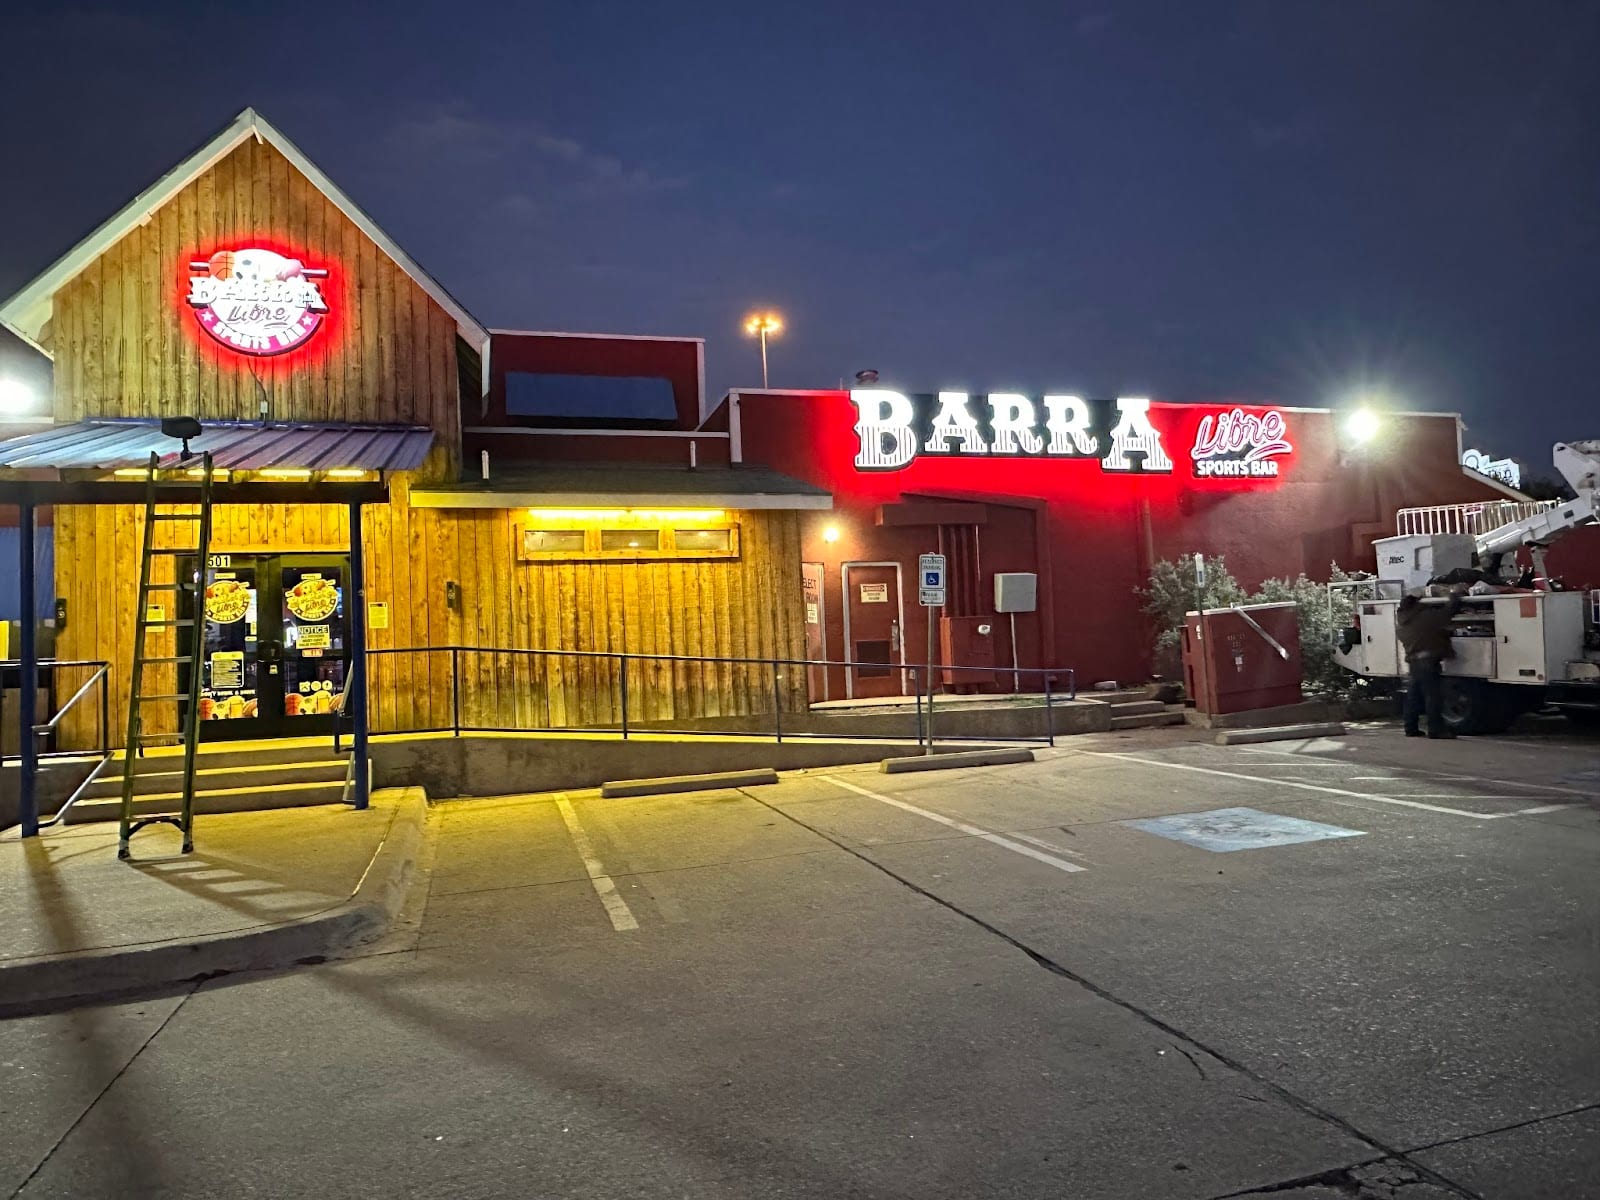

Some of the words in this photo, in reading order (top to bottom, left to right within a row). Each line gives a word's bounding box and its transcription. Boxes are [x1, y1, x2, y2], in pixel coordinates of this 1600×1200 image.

[226, 304, 290, 325] Libre
[849, 389, 1173, 471] BARRA
[1191, 408, 1287, 459] Libre
[1196, 460, 1248, 476] SPORTS
[1250, 460, 1278, 476] BAR
[298, 626, 329, 635] NOTICE
